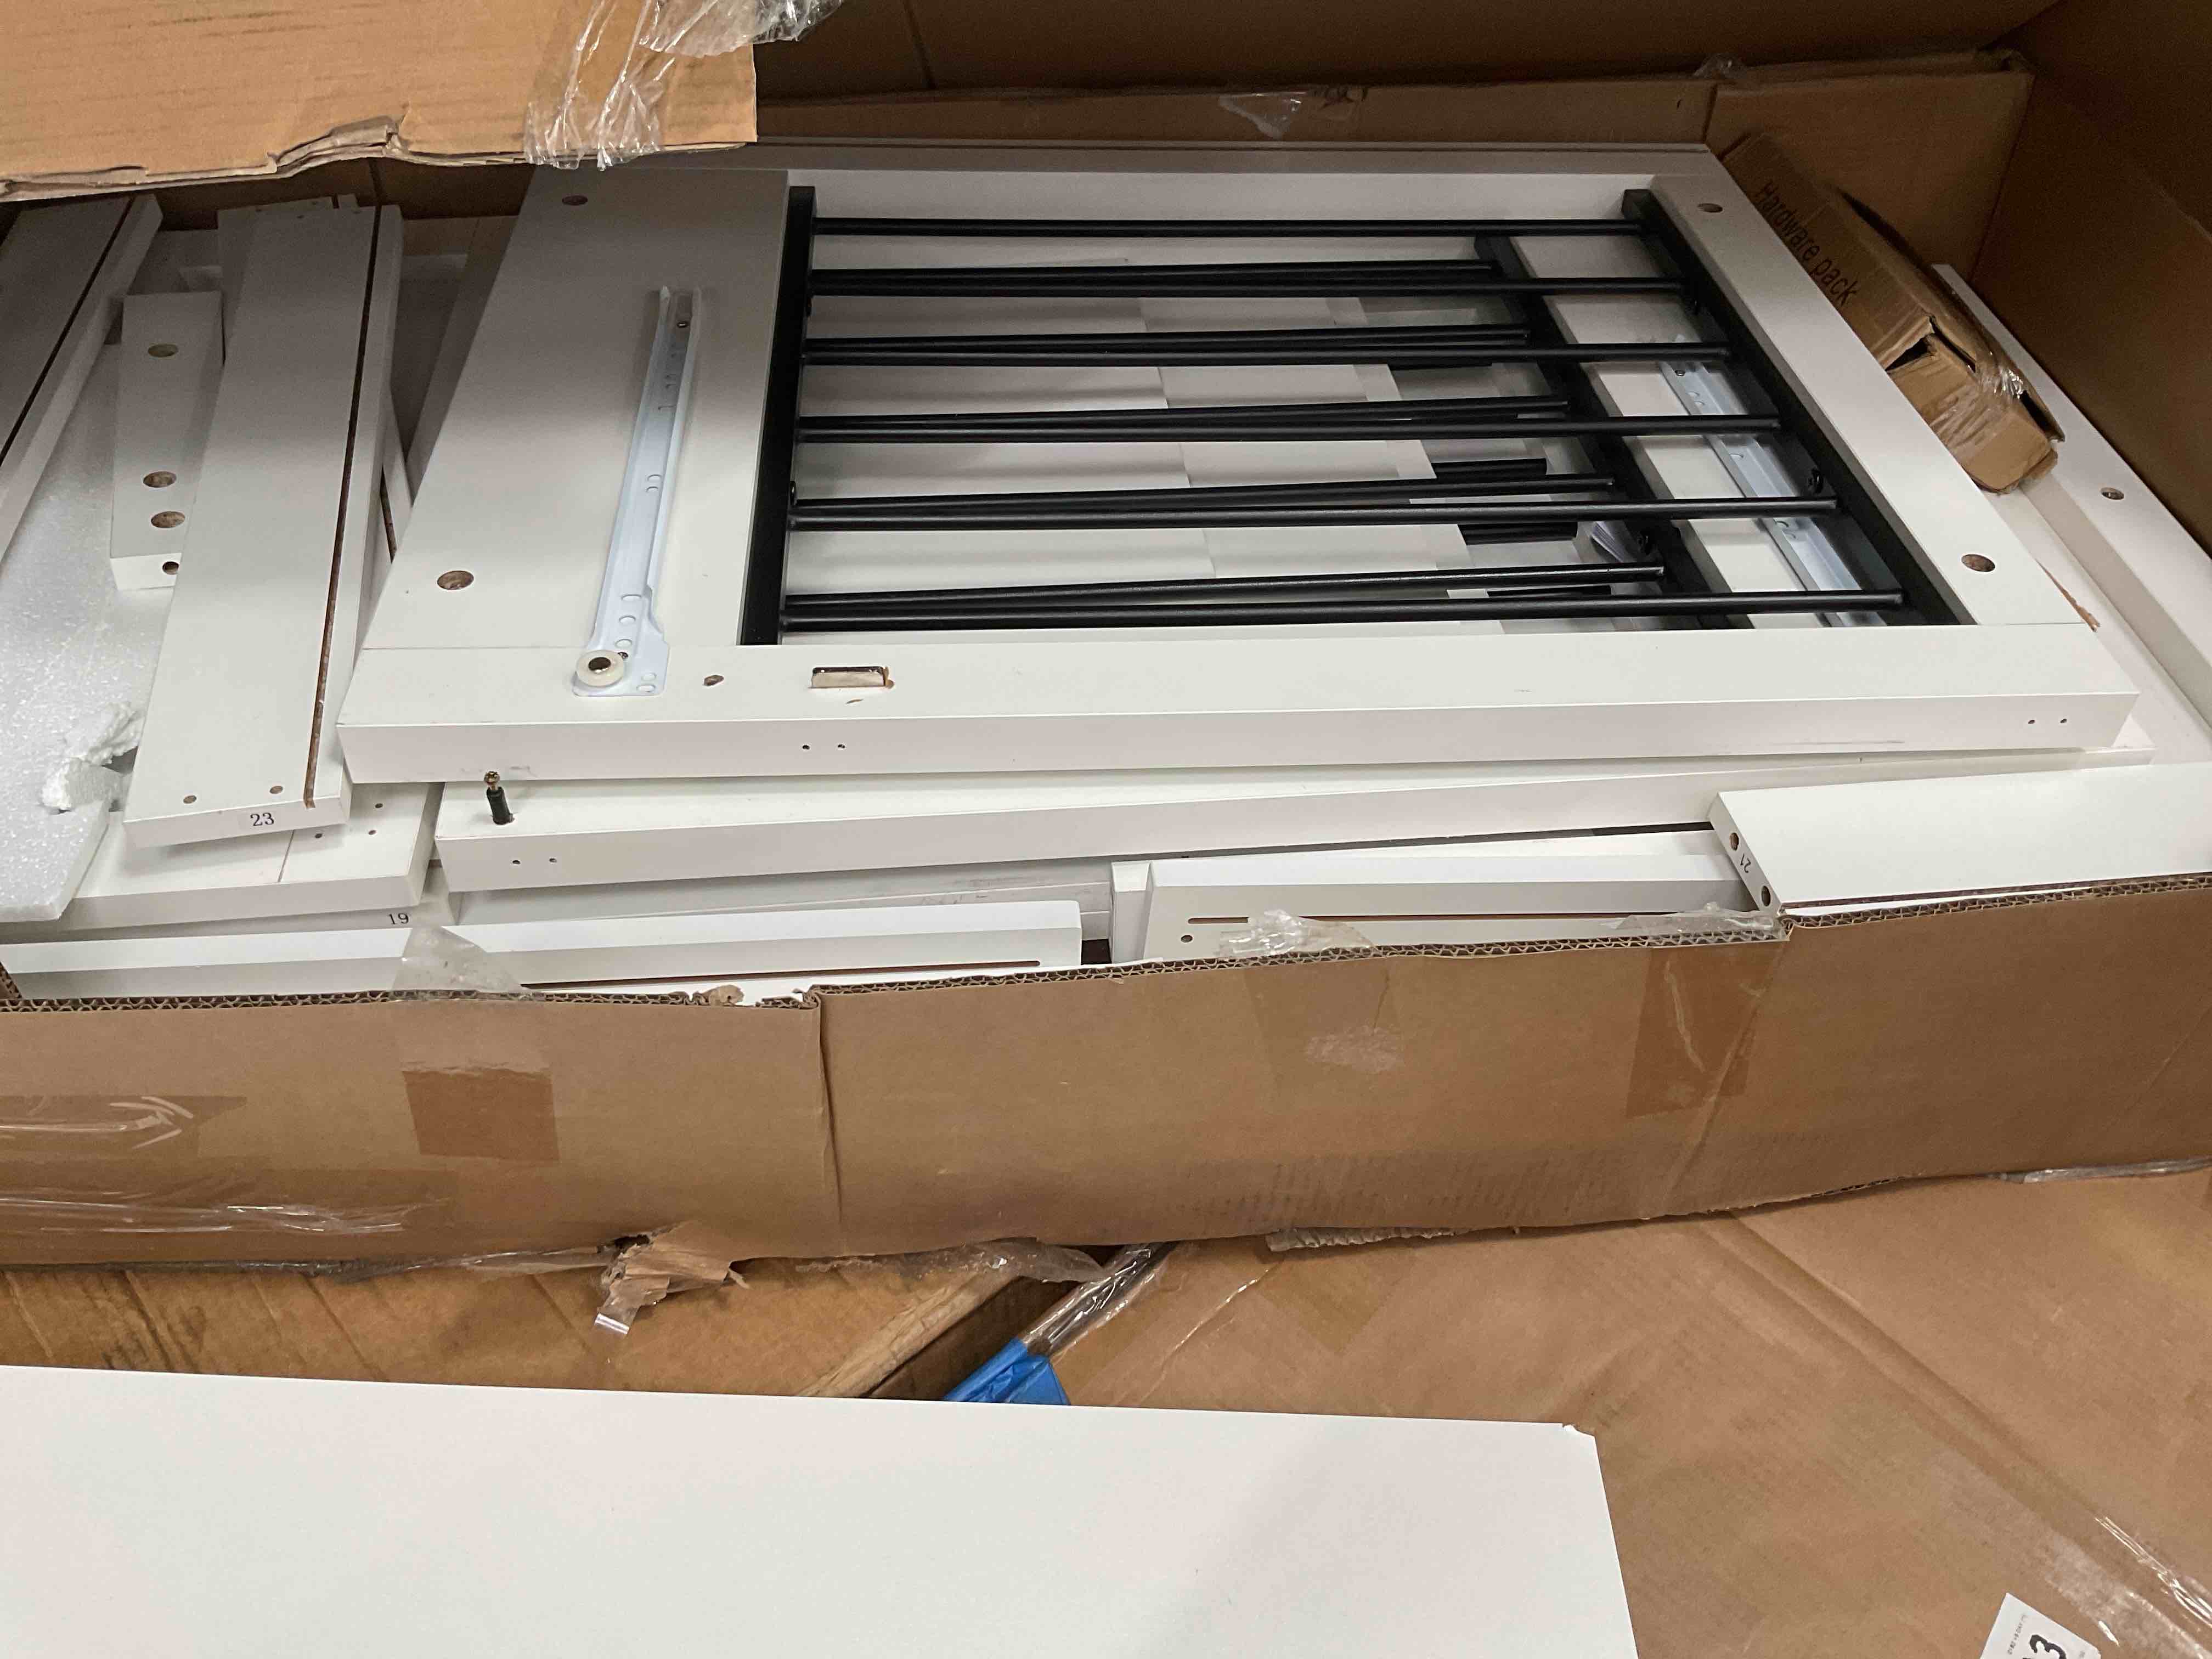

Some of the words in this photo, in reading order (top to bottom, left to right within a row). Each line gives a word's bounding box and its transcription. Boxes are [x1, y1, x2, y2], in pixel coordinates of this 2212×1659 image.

[1756, 181, 1821, 261] Hardware
[1810, 258, 1858, 307] pack
[250, 812, 275, 826] 23
[1739, 853, 1752, 873] 21
[387, 912, 409, 925] 19
